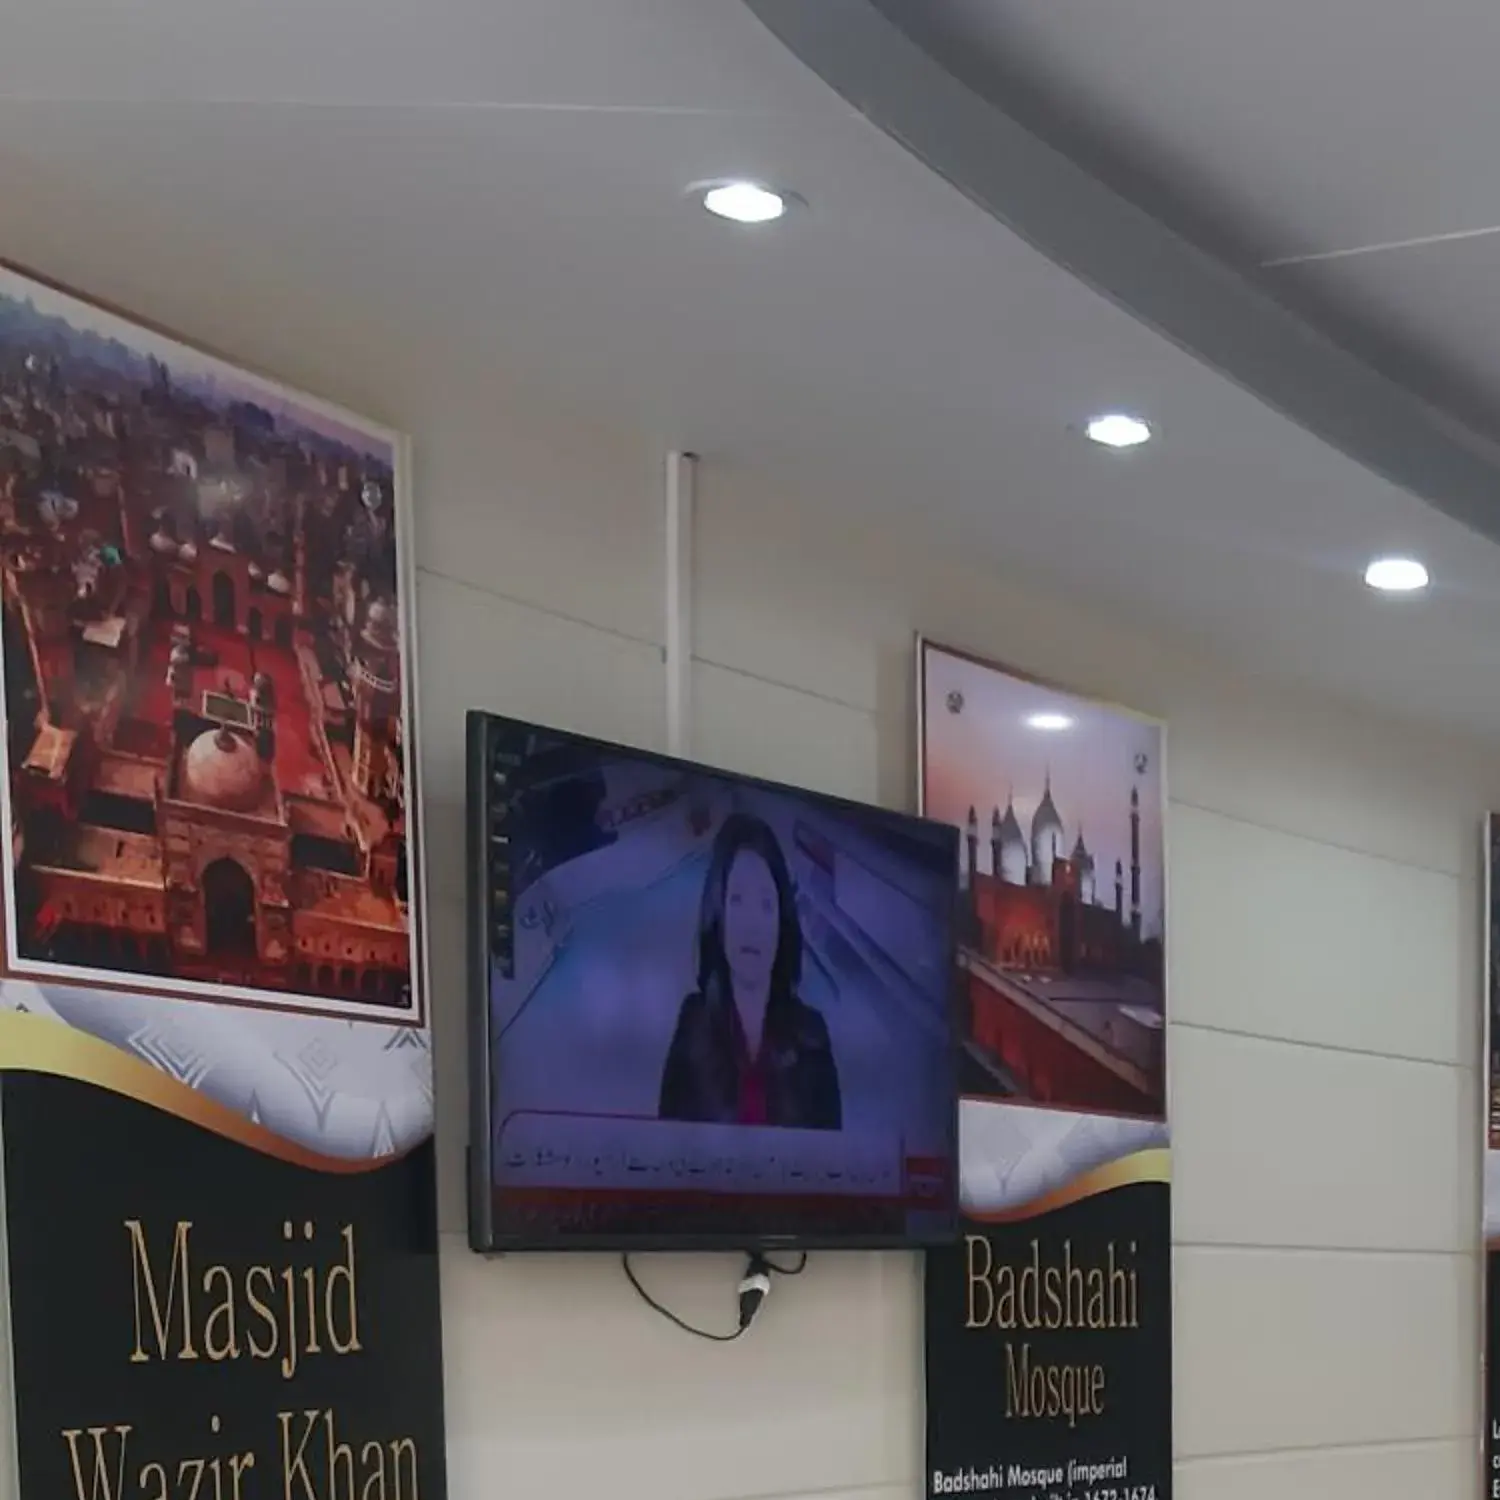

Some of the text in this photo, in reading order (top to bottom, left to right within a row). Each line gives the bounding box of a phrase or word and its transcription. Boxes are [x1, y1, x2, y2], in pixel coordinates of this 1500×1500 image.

[123, 1219, 363, 1379] Masjid
[964, 1234, 1139, 1329] Badshahi
[1005, 1341, 1105, 1428] Mosque
[933, 1456, 1127, 1494] Badshahi Mosque (imperial
